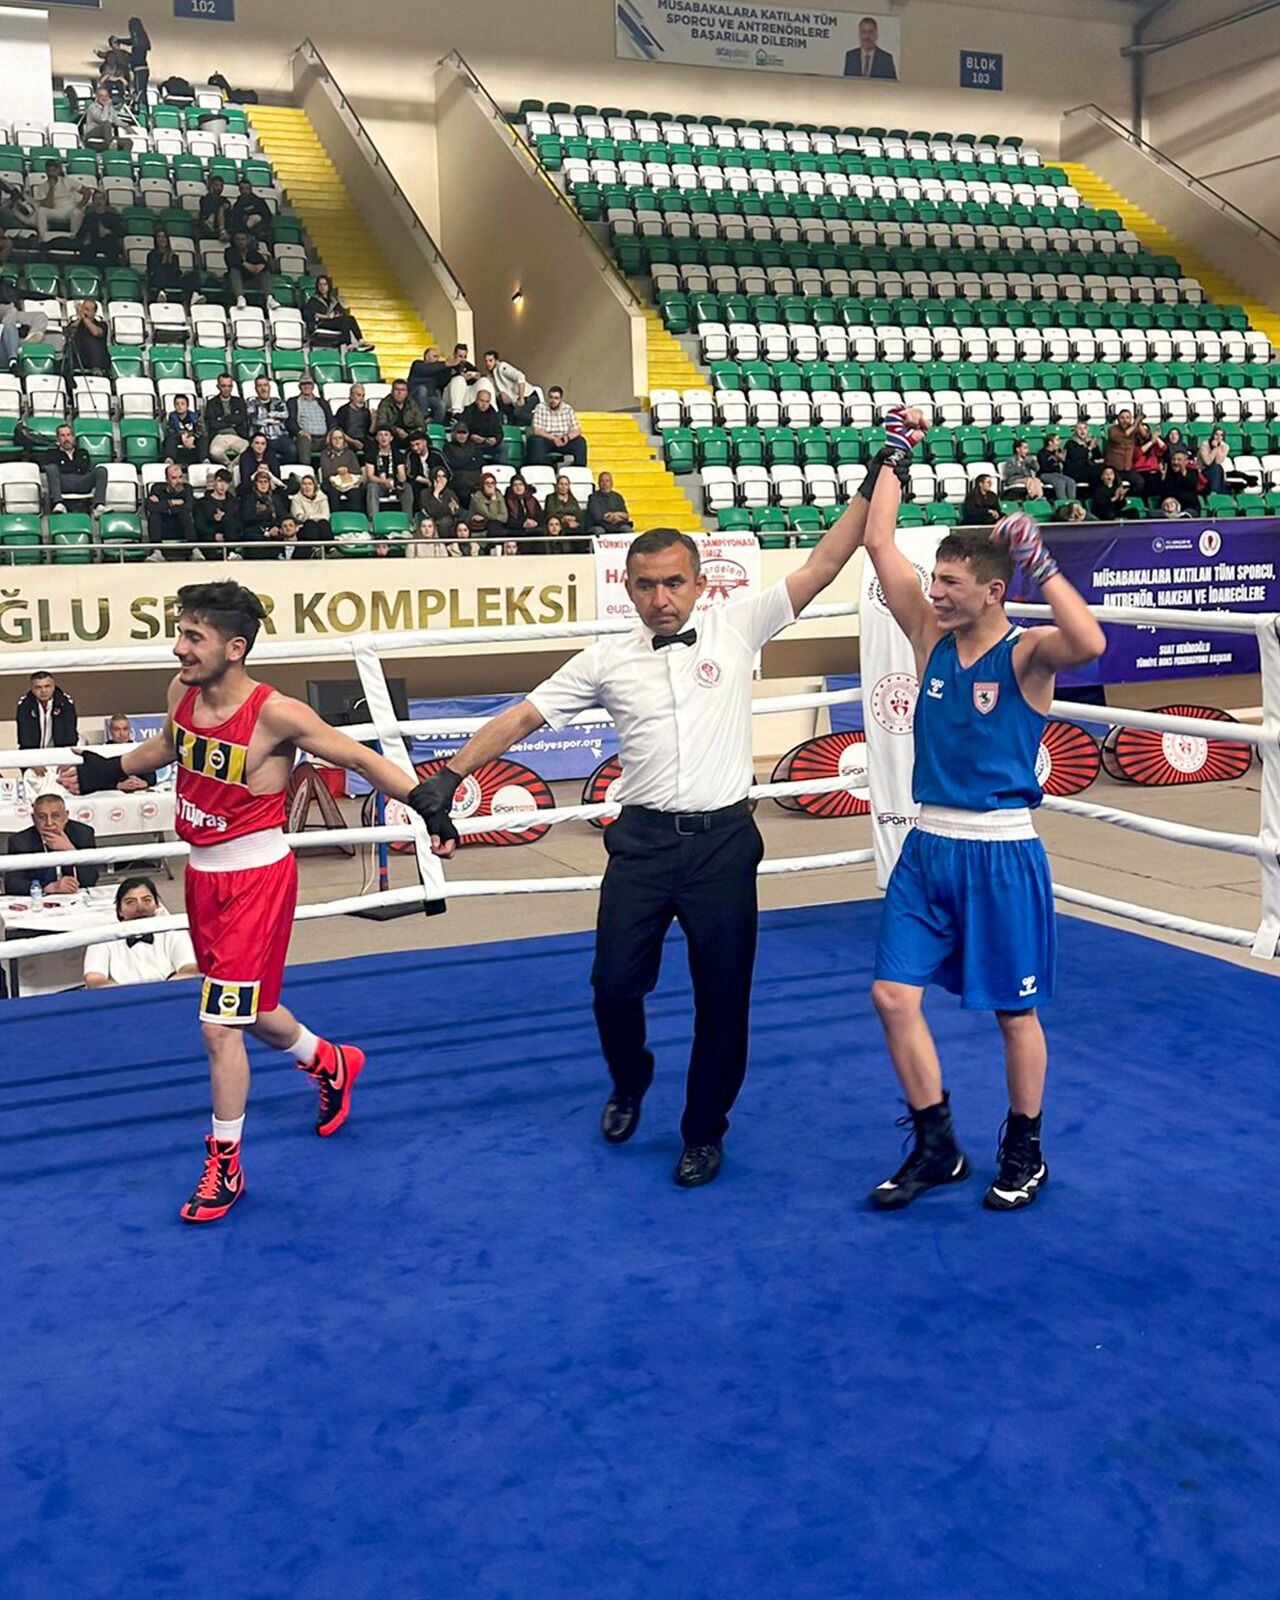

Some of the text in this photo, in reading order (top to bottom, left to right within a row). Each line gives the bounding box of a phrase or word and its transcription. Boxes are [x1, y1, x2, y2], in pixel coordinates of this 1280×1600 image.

[191, 0, 216, 13] 102
[666, 13, 830, 39] SPORCU VE ANTRENÖRLERE
[813, 12, 837, 26] TÜM
[966, 56, 996, 71] BLOK
[972, 72, 991, 84] 103
[1092, 562, 1276, 588] MÜSABAKALARA KATILAN TÜM SPORCU,
[1157, 589, 1192, 606] HAKEM
[1194, 588, 1207, 604] VE
[1208, 583, 1266, 604] İDARECİLERE
[130, 595, 277, 640] SPR
[294, 573, 578, 634] KOMPLEKSİ
